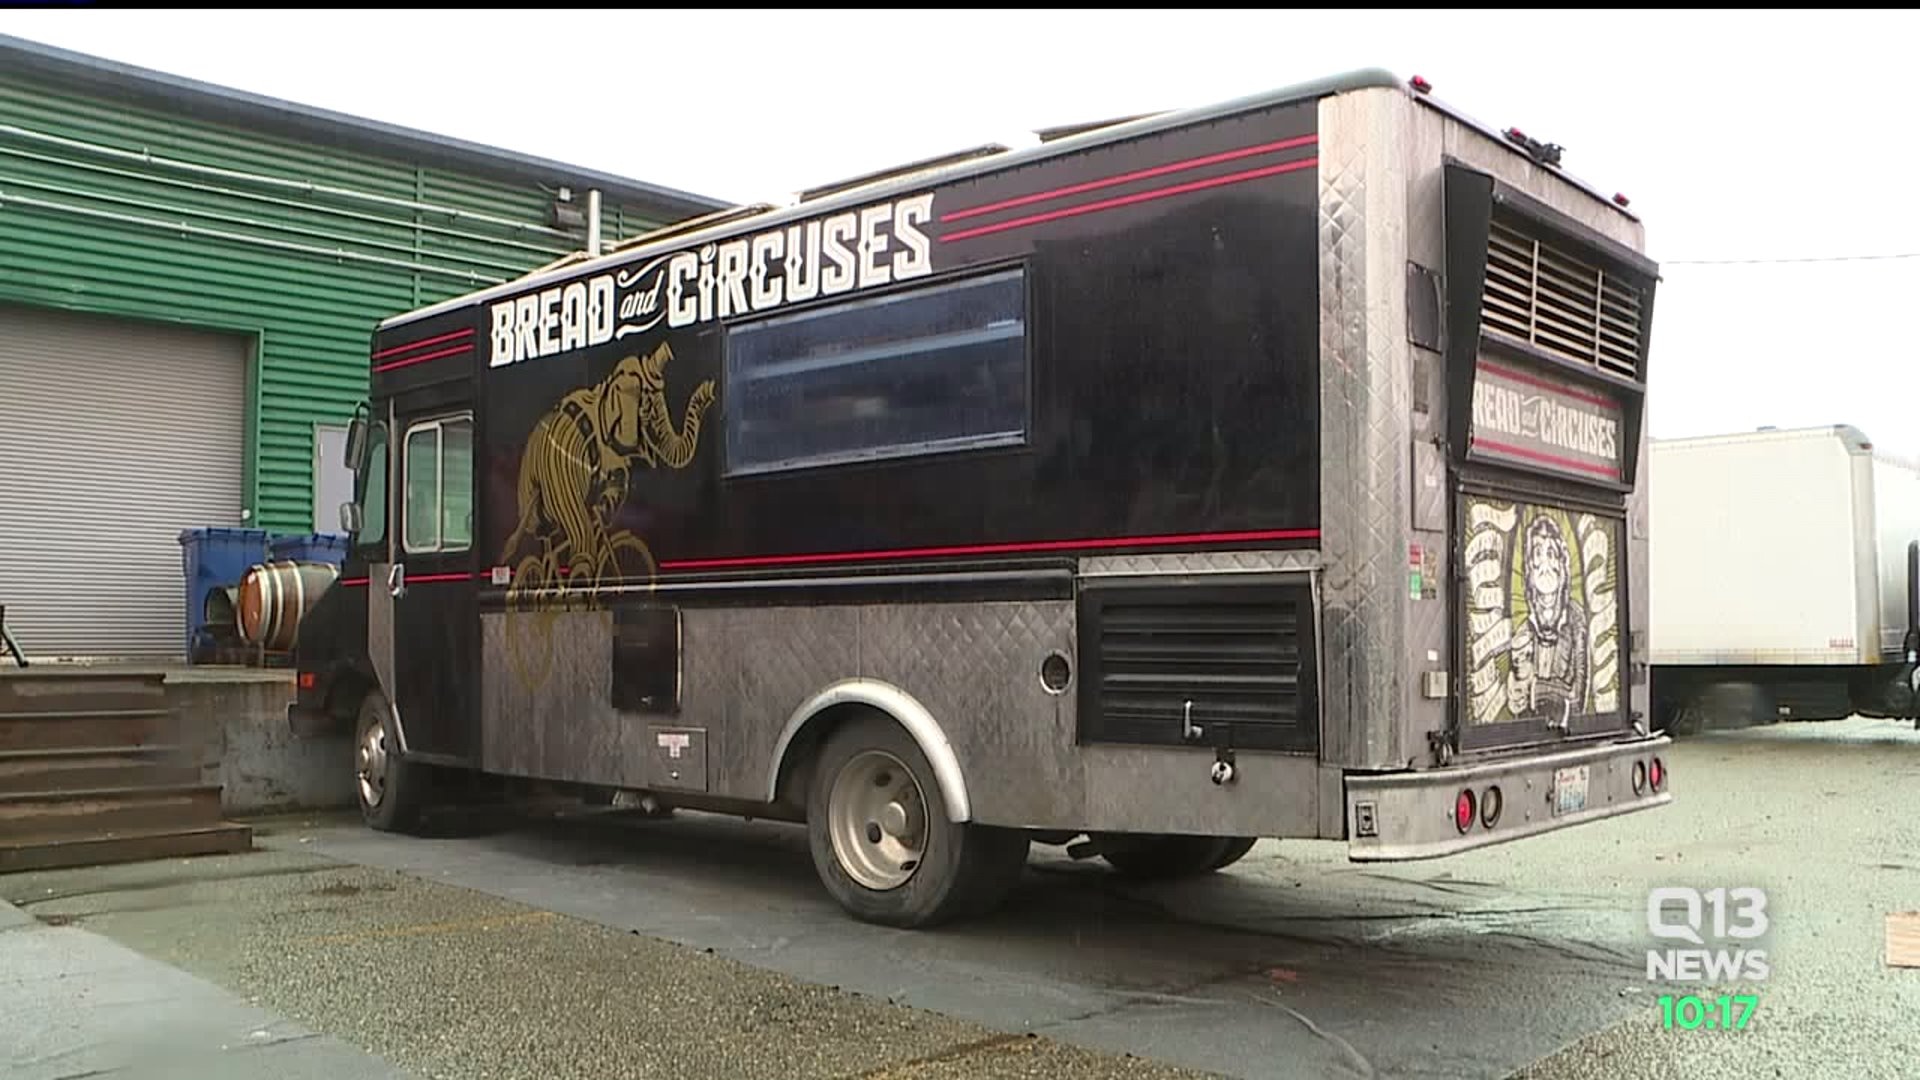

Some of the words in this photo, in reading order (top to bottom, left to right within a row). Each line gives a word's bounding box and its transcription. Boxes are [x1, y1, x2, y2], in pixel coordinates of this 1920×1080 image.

[490, 274, 615, 368] BREAD
[619, 269, 664, 320] and
[1472, 380, 1520, 435] READ
